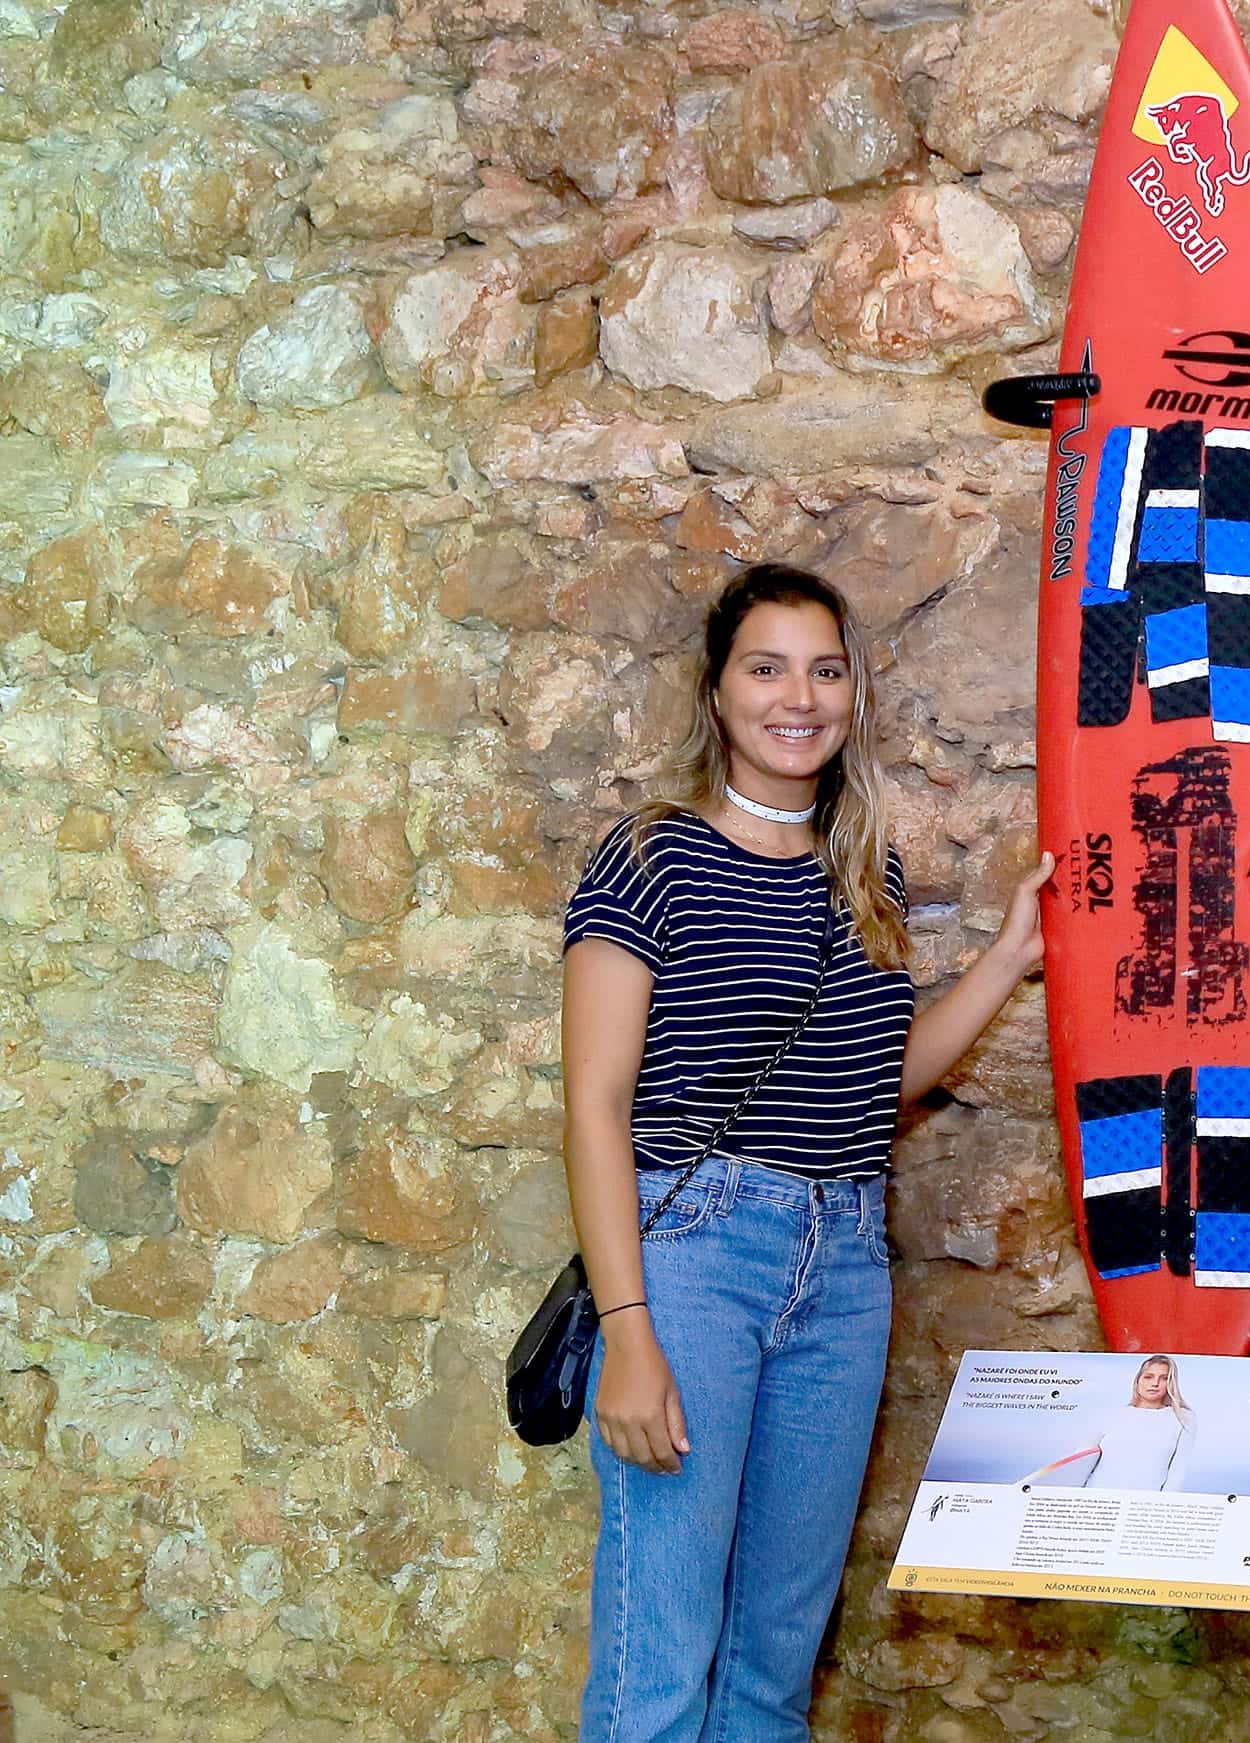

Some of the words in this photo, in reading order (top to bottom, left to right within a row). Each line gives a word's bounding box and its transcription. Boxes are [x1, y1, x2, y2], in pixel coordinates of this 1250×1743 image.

[1050, 453, 1087, 582] RAWSON
[1069, 839, 1082, 914] ULTRA
[1086, 832, 1114, 914] SKOL
[1045, 1582, 1064, 1591] NÃO
[1065, 1584, 1097, 1593] MEXER
[1112, 1586, 1156, 1597] PRANCHA
[1168, 1590, 1181, 1598] DO
[1183, 1591, 1203, 1599] NOT
[1206, 1592, 1237, 1601] TOUCH
